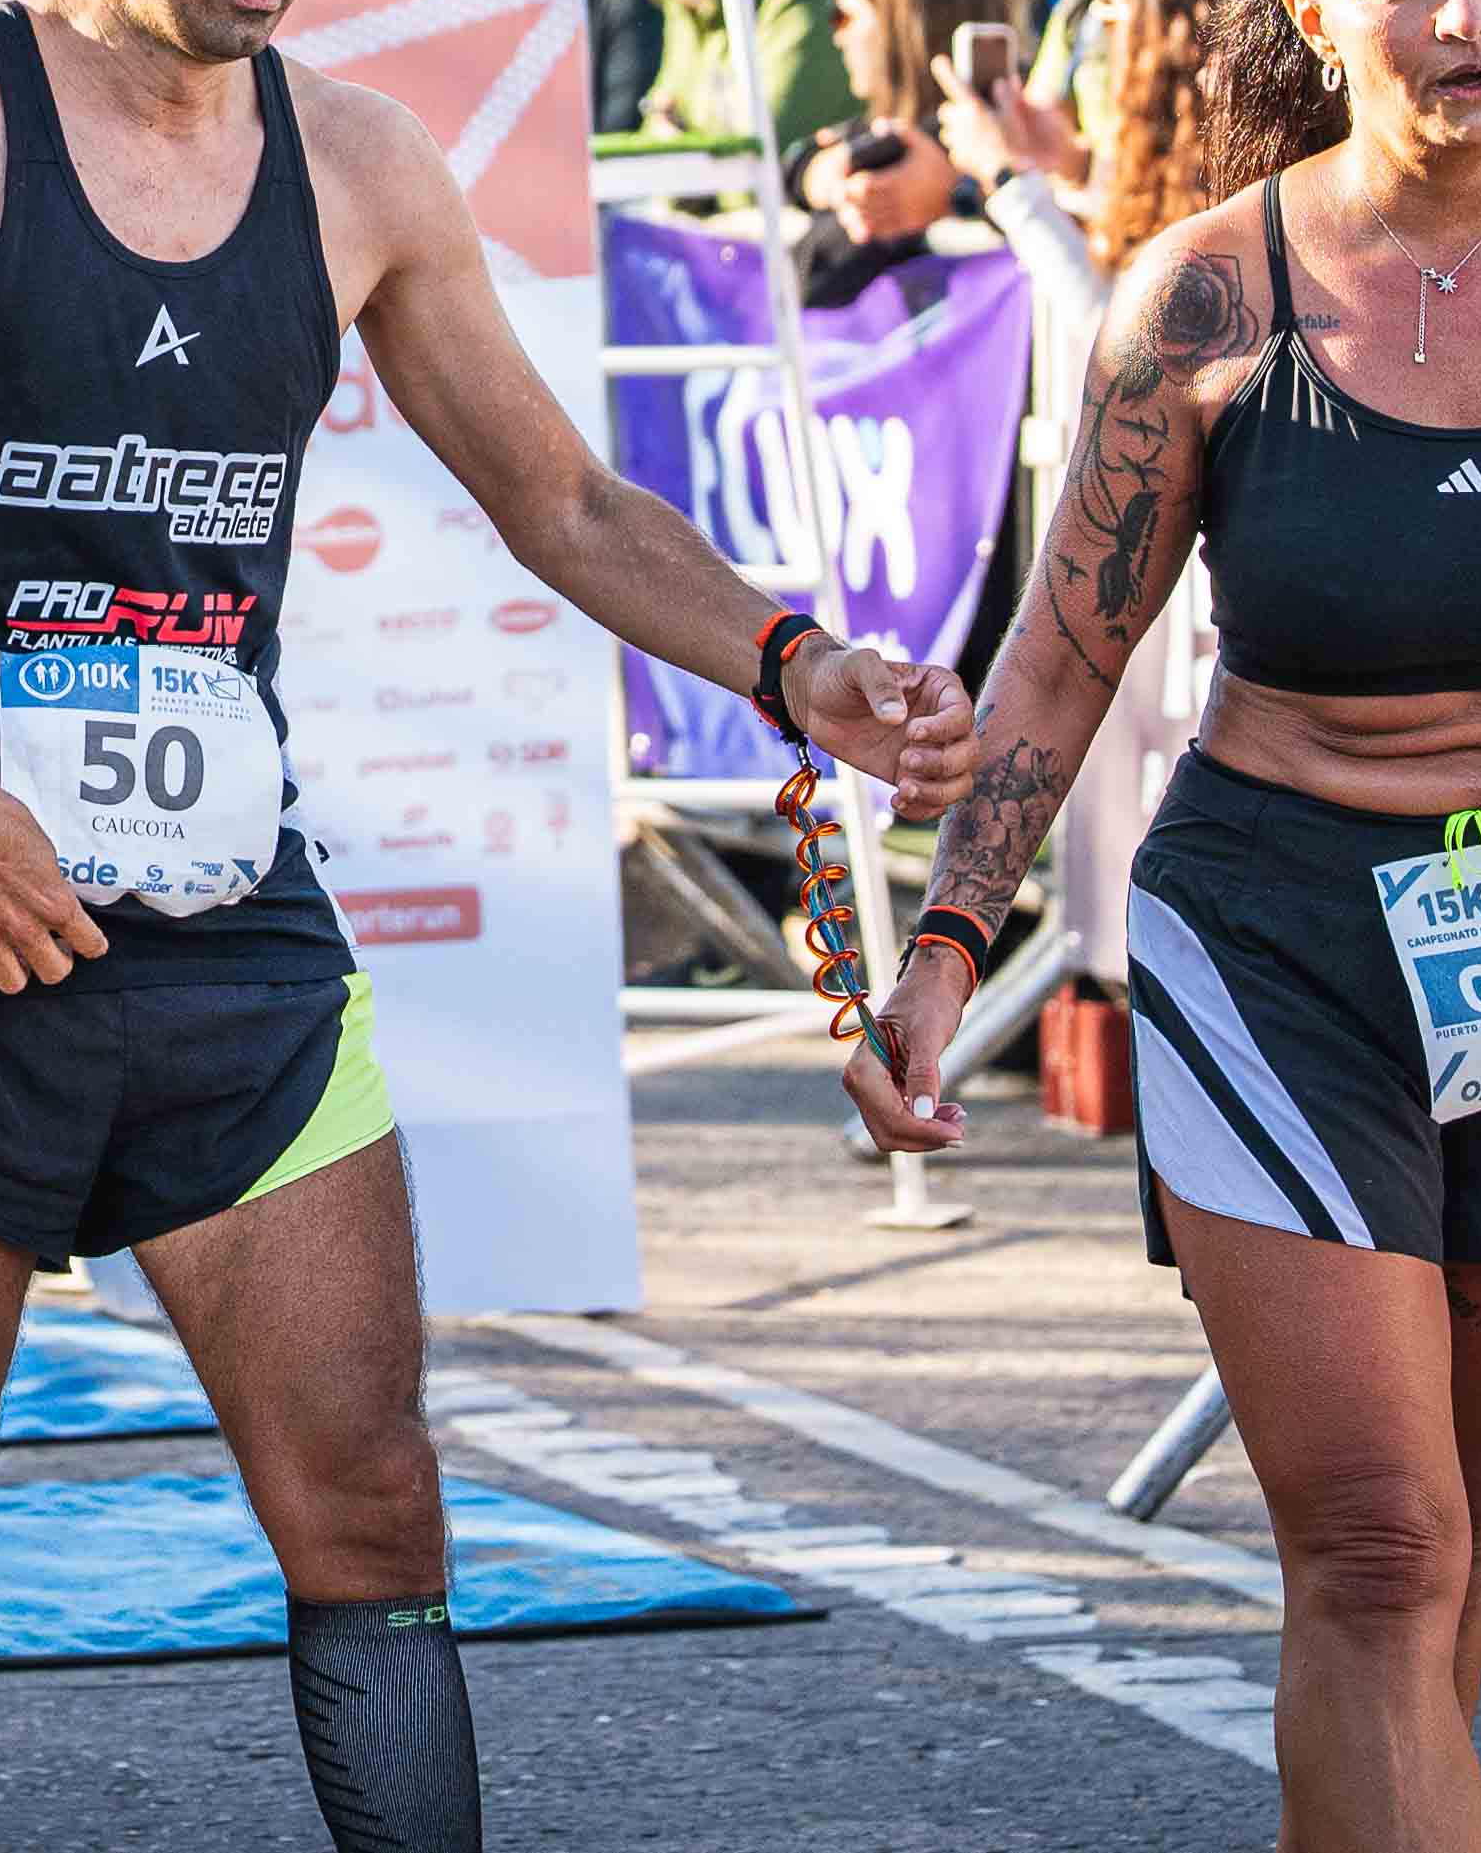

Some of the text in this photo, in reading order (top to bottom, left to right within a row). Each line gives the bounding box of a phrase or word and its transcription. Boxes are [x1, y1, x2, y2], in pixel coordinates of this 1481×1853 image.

[170, 503, 273, 544] athlete
[78, 662, 131, 690] 10K
[151, 666, 199, 695] 15K
[79, 719, 204, 812] 50
[92, 815, 185, 841] CAUCOTA
[57, 856, 119, 885] sde
[1407, 925, 1478, 948] CAMPEONATO
[1436, 1025, 1478, 1041] PUERTO
[387, 1605, 445, 1627] SO
